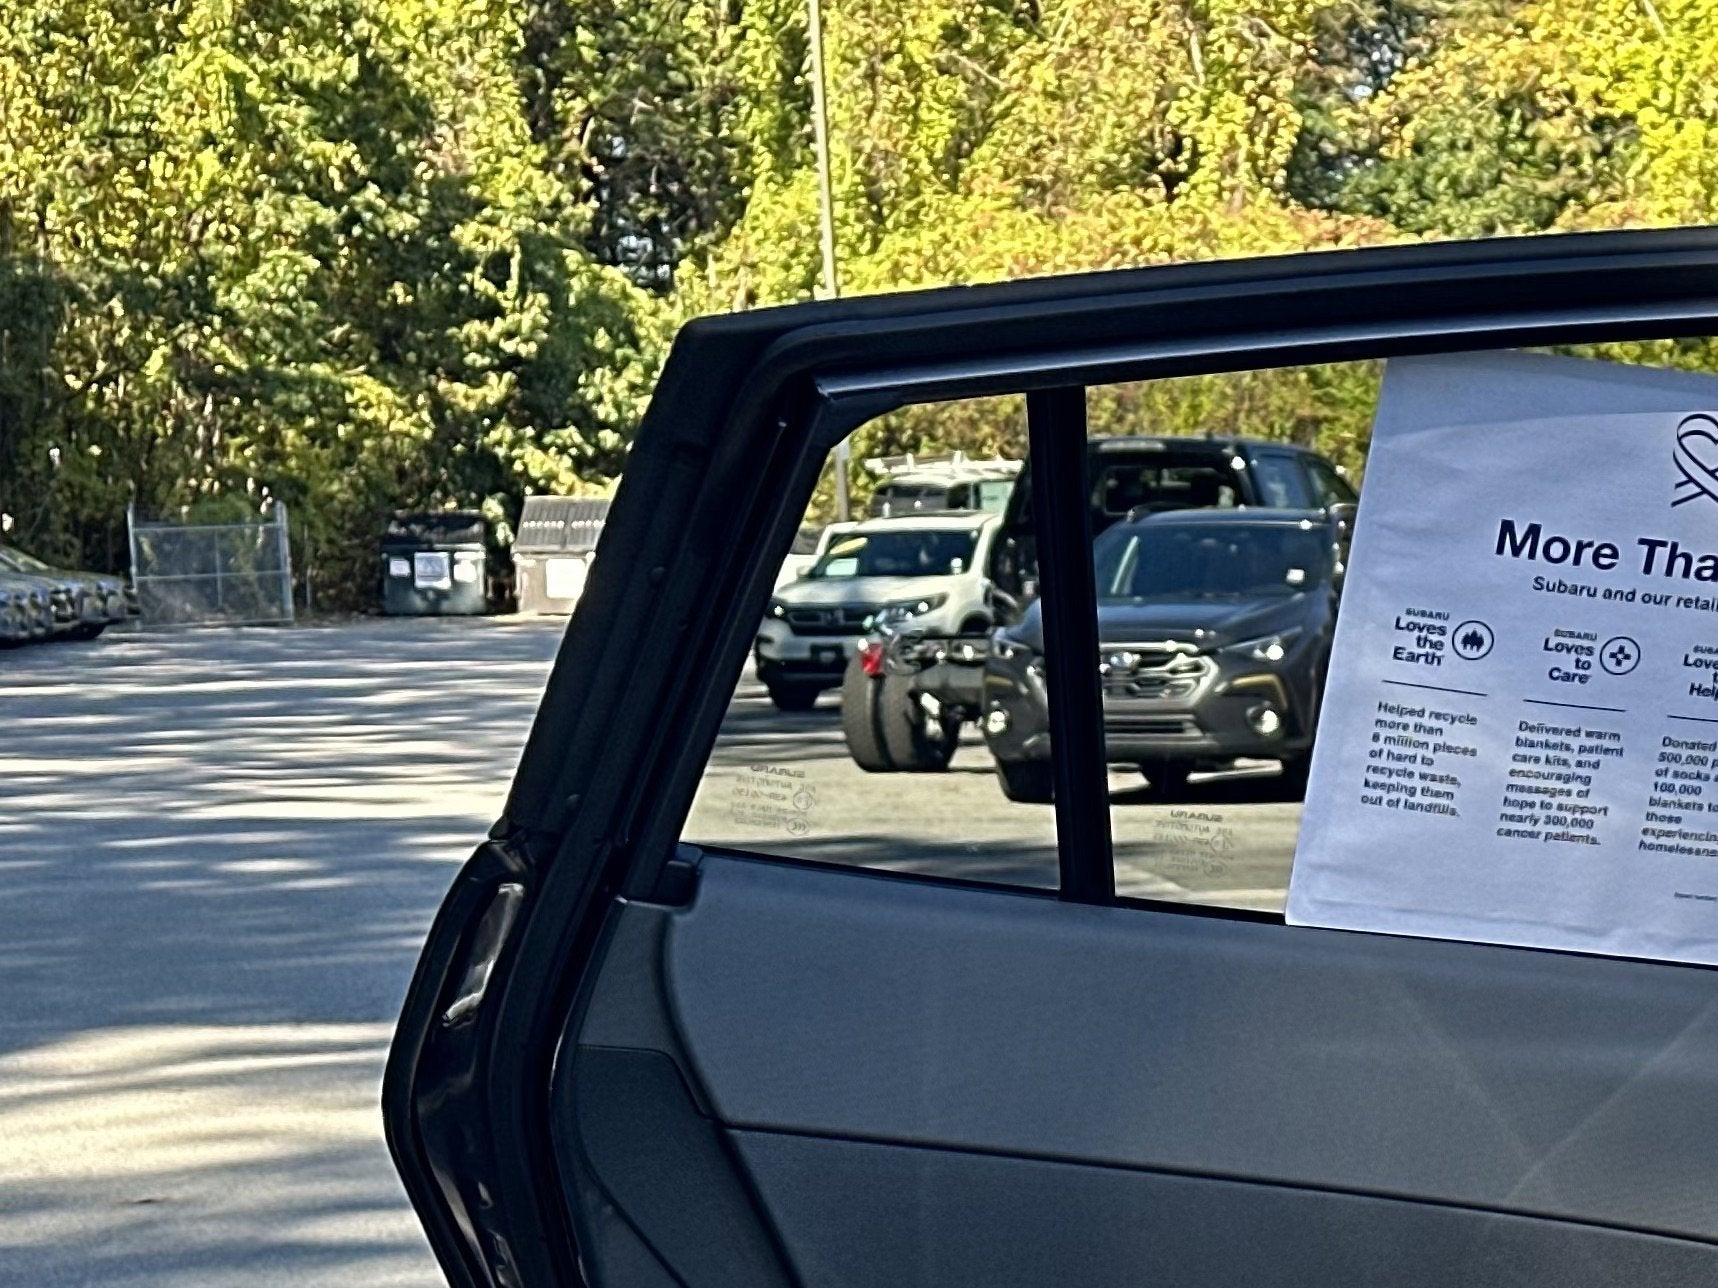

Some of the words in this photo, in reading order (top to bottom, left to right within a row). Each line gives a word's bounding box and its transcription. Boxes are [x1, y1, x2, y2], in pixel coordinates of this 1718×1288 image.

[1495, 519, 1620, 571] More
[1532, 575, 1598, 598] Subaru
[1601, 588, 1637, 603] and
[1640, 592, 1673, 607] our
[1405, 608, 1449, 621] SUBARU
[1395, 616, 1447, 636] Loves
[1554, 629, 1597, 641] SUBARU
[1416, 635, 1444, 651] the
[1544, 638, 1594, 656] Loves
[1393, 647, 1444, 666] Earth
[1575, 657, 1591, 670] to
[1549, 667, 1591, 684] Care
[1377, 701, 1426, 719] Helped
[1428, 710, 1478, 726] recycle
[1374, 718, 1411, 732] more
[1412, 721, 1444, 737] than
[1518, 720, 1582, 738] Delivered
[1584, 730, 1621, 743] warm
[1383, 734, 1430, 751] million
[1432, 741, 1478, 757] pieces
[1514, 735, 1575, 754] blankets,
[1577, 744, 1624, 758] patient
[1661, 735, 1718, 753] Donated
[1368, 748, 1384, 760] of
[1386, 749, 1418, 765] hard
[1420, 754, 1435, 767] to
[1511, 753, 1542, 765] care
[1544, 753, 1572, 769] kits,
[1574, 758, 1601, 770] and
[1657, 751, 1709, 767] 500,000
[1365, 764, 1416, 780] recycle
[1418, 771, 1462, 789] waste,
[1508, 768, 1592, 787] encouraging
[1654, 766, 1670, 779] of
[1671, 769, 1711, 782] socks
[1363, 777, 1418, 798] keeping
[1420, 785, 1455, 801] them
[1505, 783, 1573, 799] messages
[1575, 788, 1591, 799] of
[1653, 781, 1703, 796] 100,000
[1360, 794, 1384, 807] out
[1385, 797, 1402, 809] of
[1403, 798, 1460, 817] landfills.
[1502, 796, 1537, 811] hope
[1539, 799, 1554, 811] to
[1555, 802, 1609, 817] support
[1648, 795, 1705, 812] blankets
[1499, 812, 1541, 827] nearly
[1543, 814, 1595, 830] 300,000
[1645, 811, 1683, 825] those
[1496, 827, 1542, 840] cancer
[1543, 830, 1601, 846] patients.
